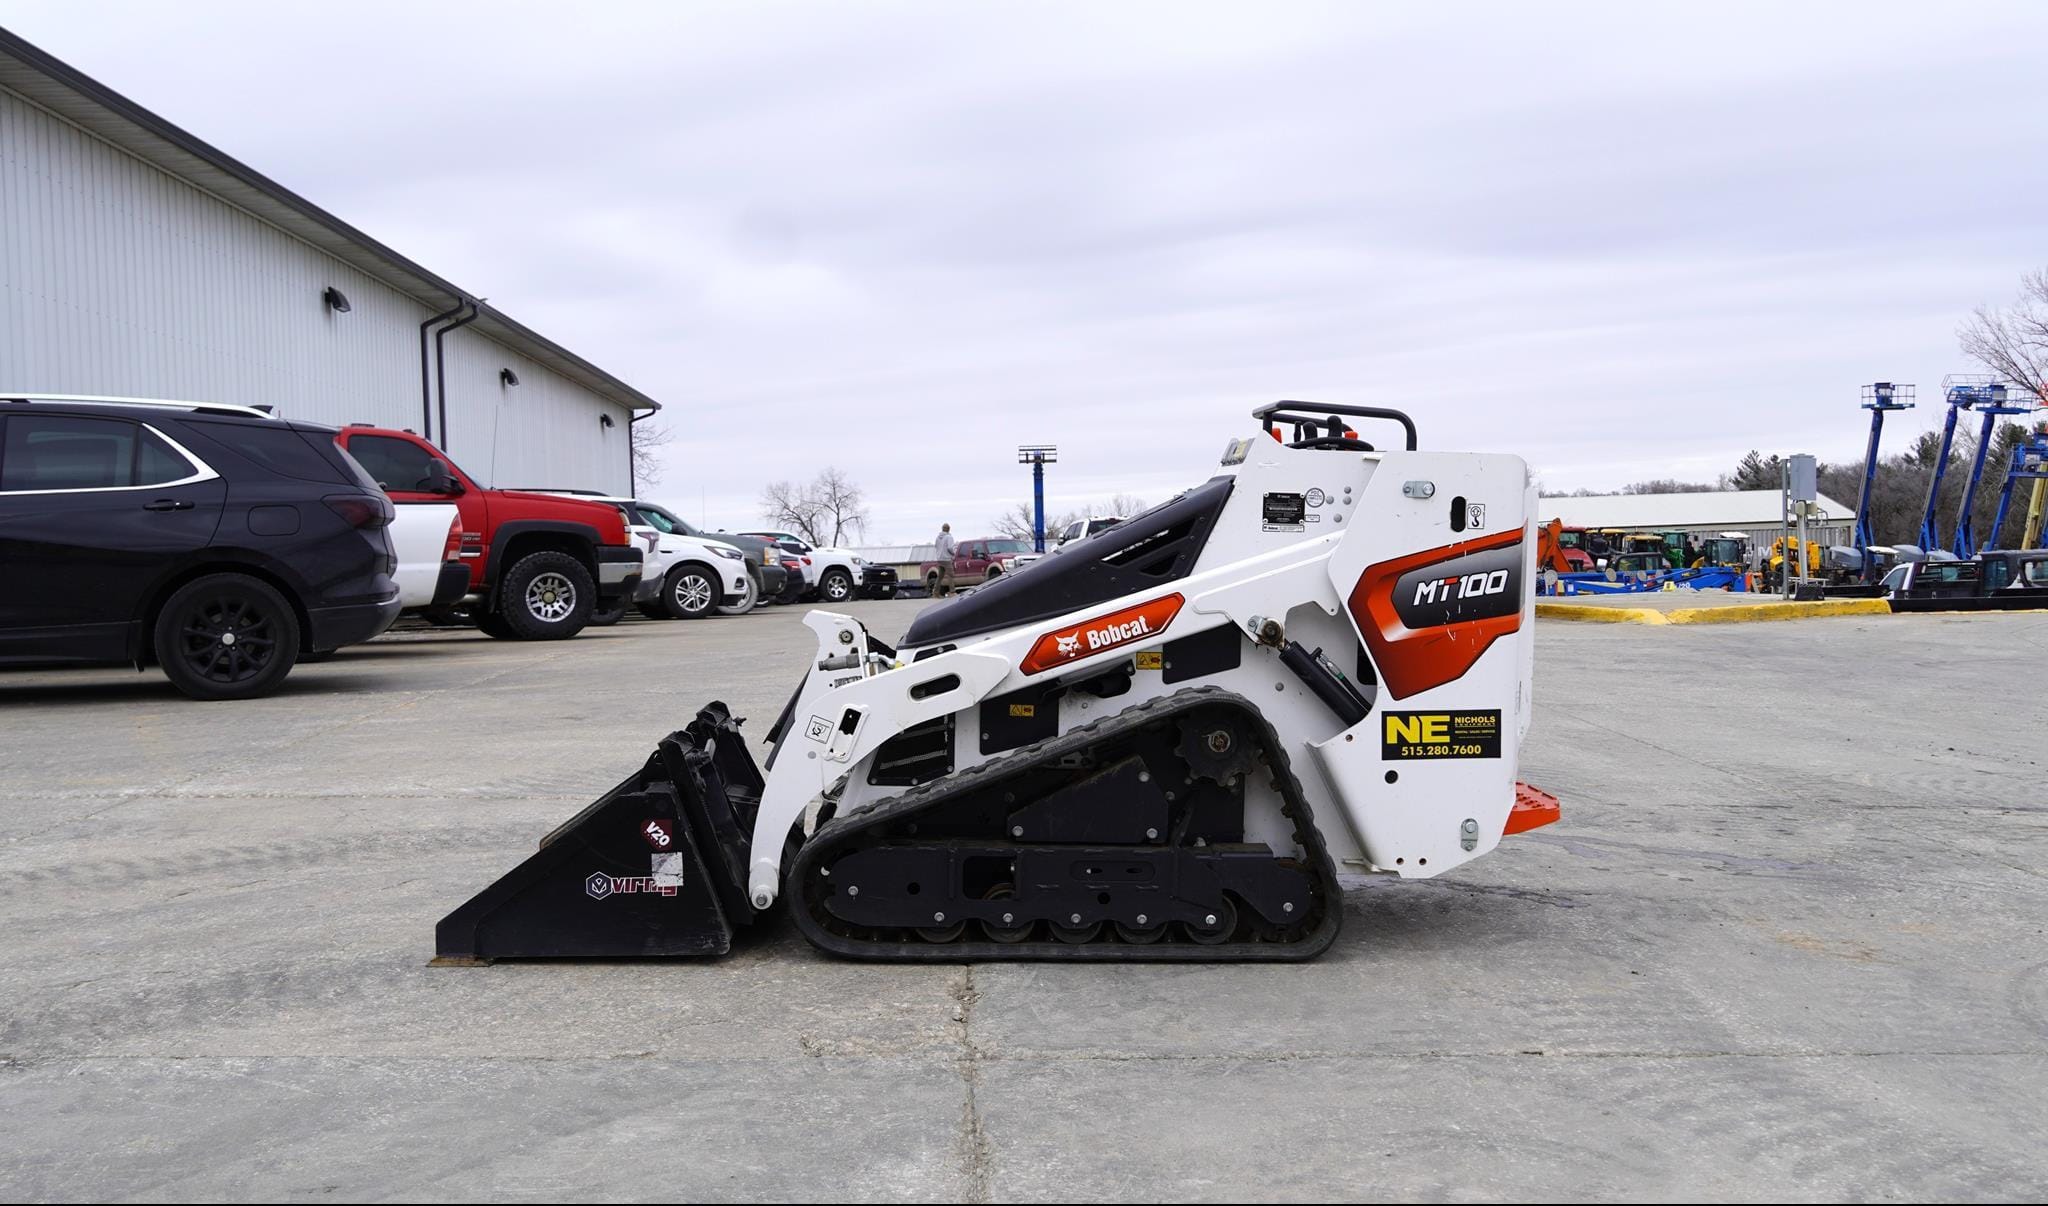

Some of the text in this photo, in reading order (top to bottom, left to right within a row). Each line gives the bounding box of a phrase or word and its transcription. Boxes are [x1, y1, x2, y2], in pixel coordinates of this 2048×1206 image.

[1413, 569, 1509, 606] MT100
[1086, 615, 1149, 650] Bobcat
[1386, 715, 1450, 744] NE
[1454, 716, 1496, 724] NICHOLS
[1401, 745, 1482, 756] 515.280.7600
[646, 821, 670, 846] V20
